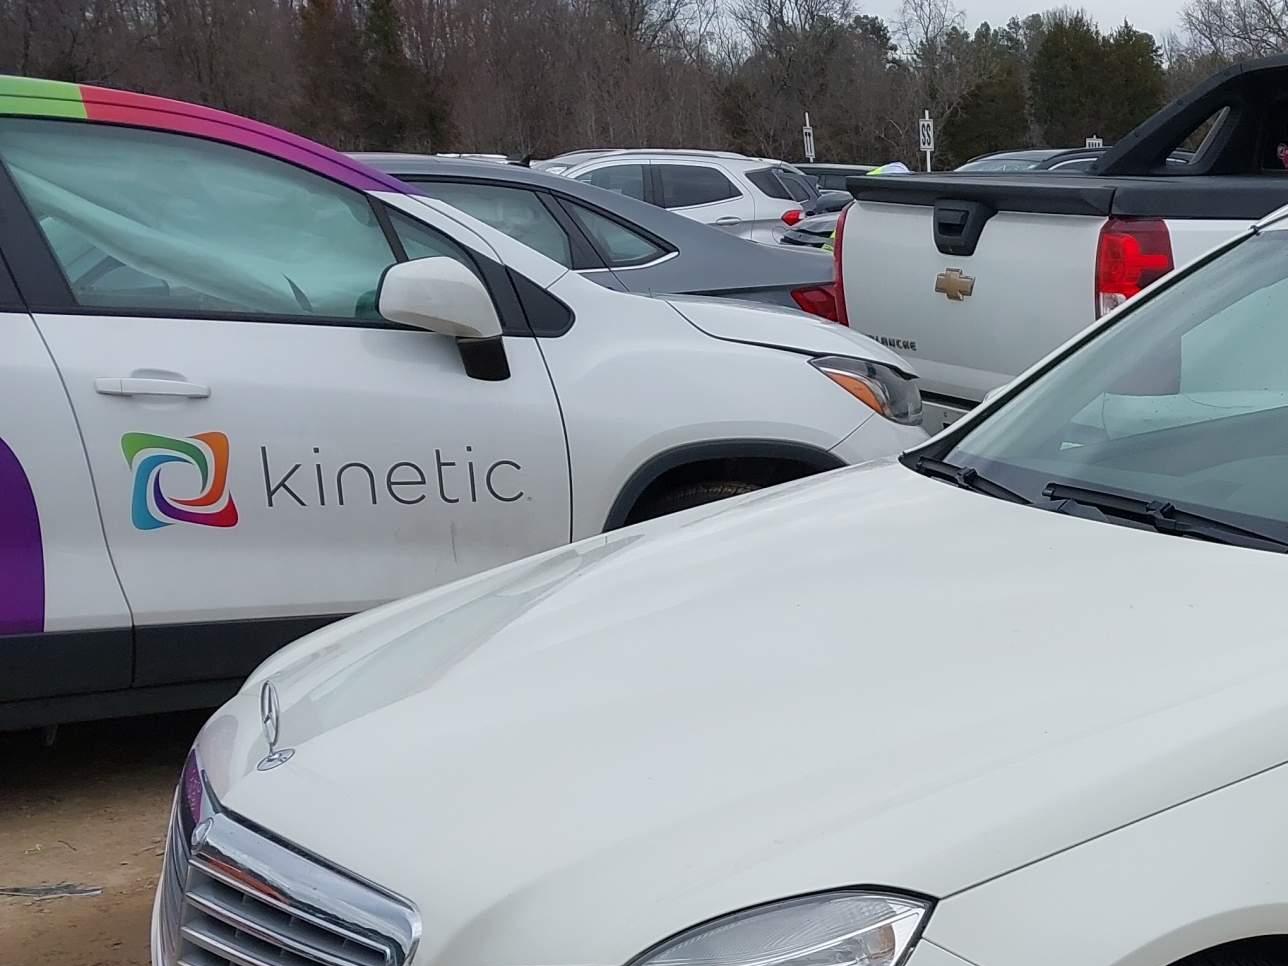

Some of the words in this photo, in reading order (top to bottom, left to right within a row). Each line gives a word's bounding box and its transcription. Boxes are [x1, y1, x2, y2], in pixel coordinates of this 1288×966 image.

[804, 131, 813, 154] TT
[921, 123, 931, 146] SS
[261, 446, 524, 507] kinetic
